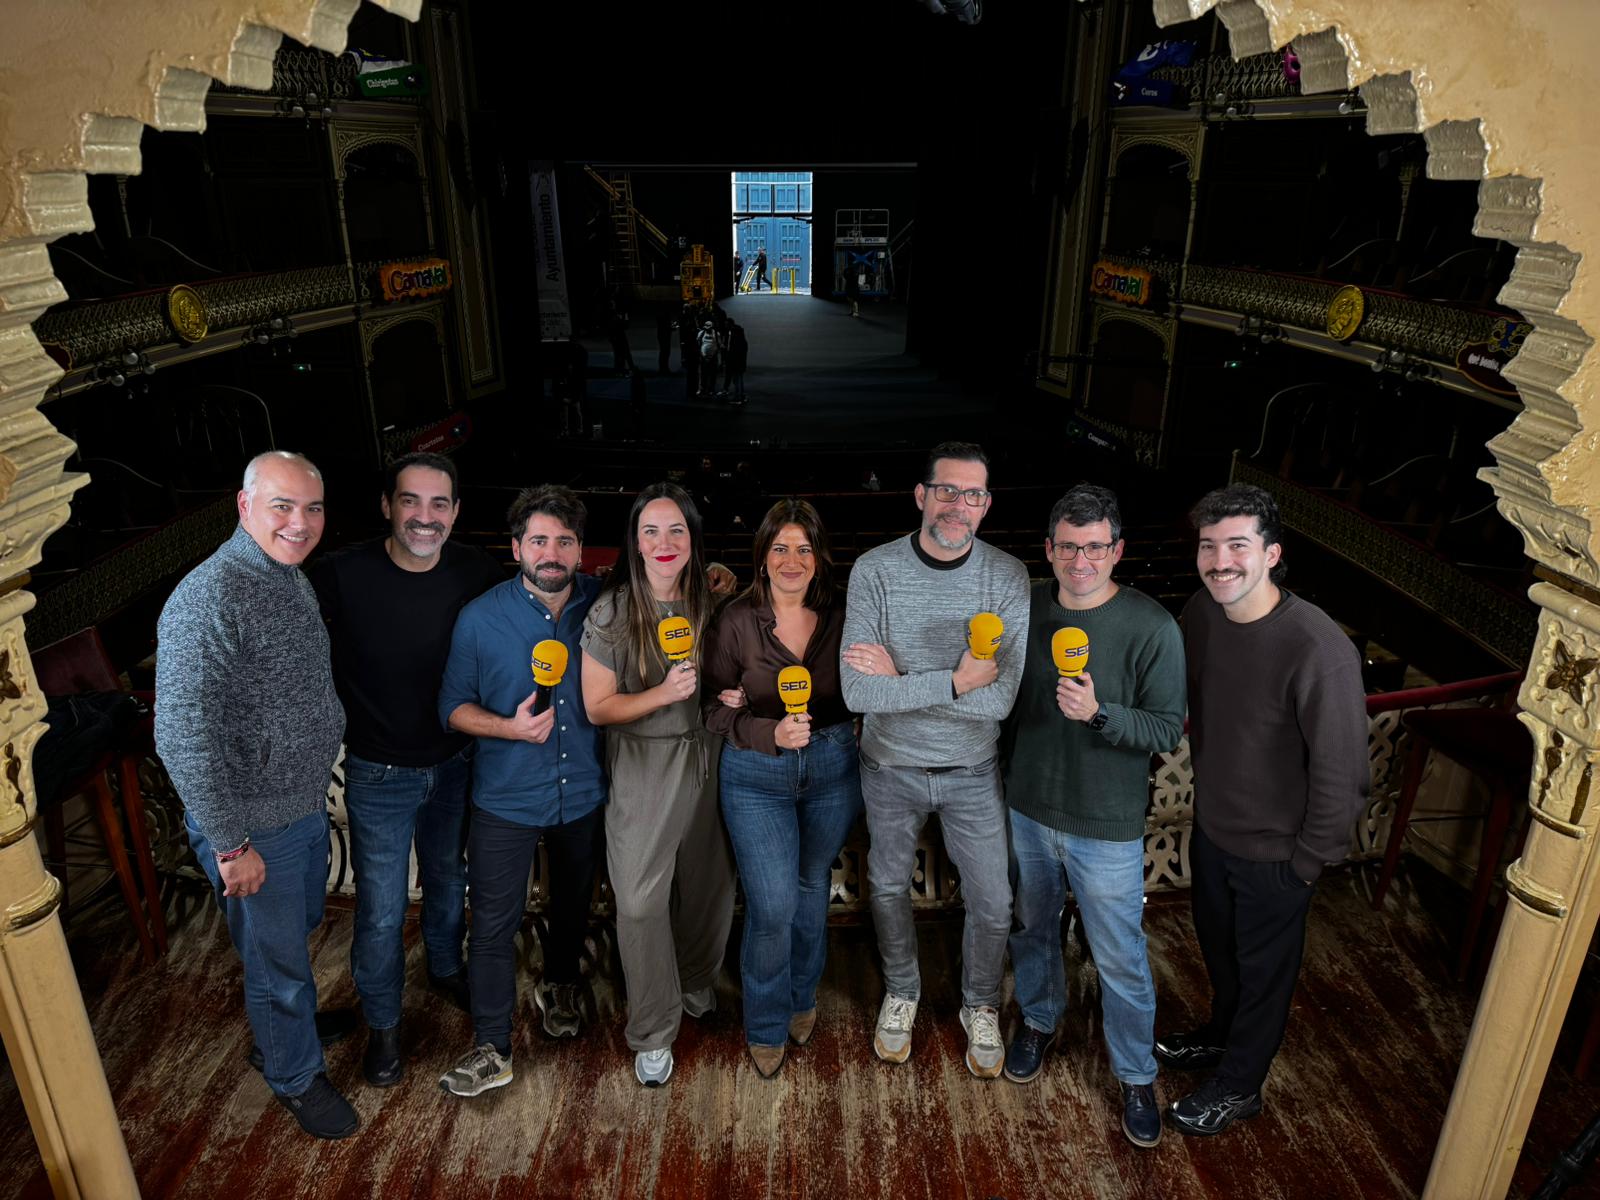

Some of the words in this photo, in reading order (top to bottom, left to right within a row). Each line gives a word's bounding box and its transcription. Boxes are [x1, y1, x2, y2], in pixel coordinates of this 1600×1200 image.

[538, 193, 561, 282] Ayuntamiento
[387, 263, 449, 297] Carnaval
[1094, 267, 1144, 300] Carnaval
[1064, 644, 1088, 658] SE
[532, 657, 552, 672] ER
[780, 680, 809, 692] SER
